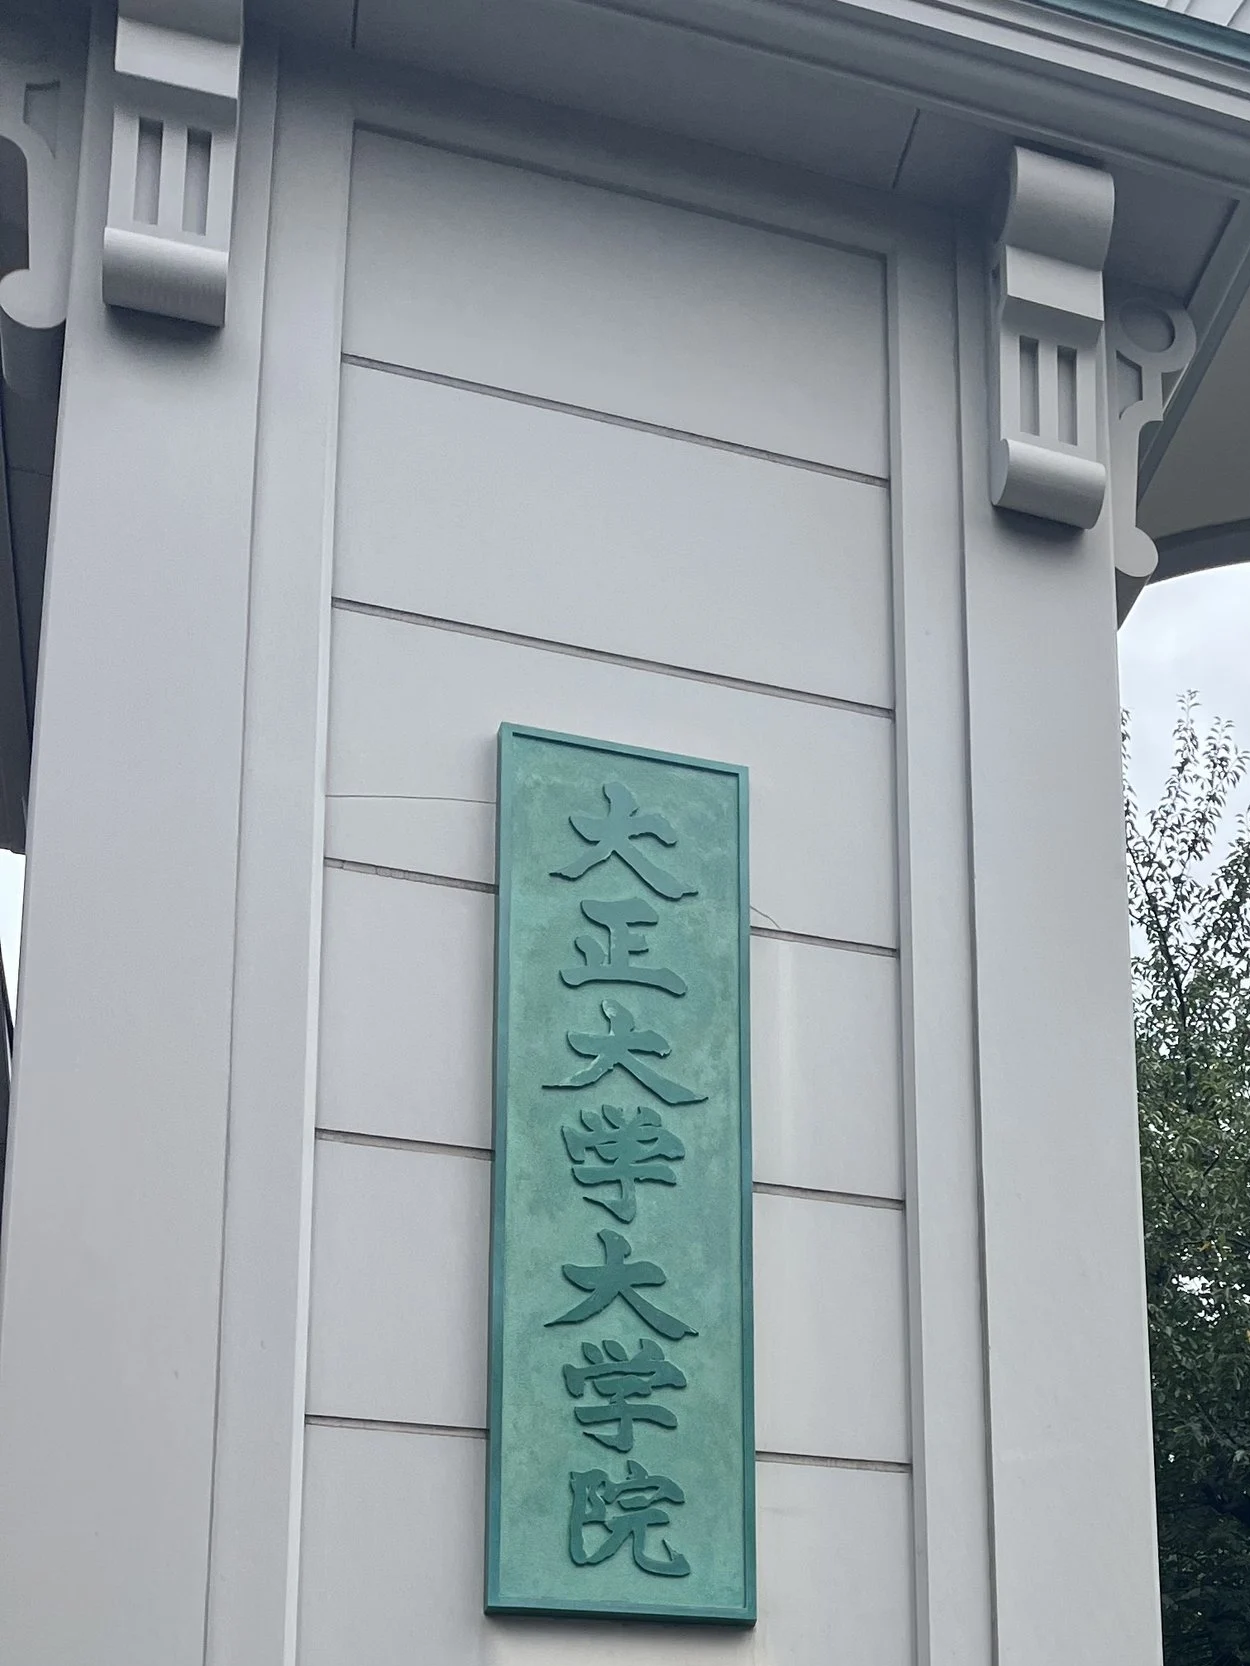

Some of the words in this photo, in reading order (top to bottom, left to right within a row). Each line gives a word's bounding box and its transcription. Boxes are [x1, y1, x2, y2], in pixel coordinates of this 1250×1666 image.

[544, 782, 708, 1577] 大正大学大学院
